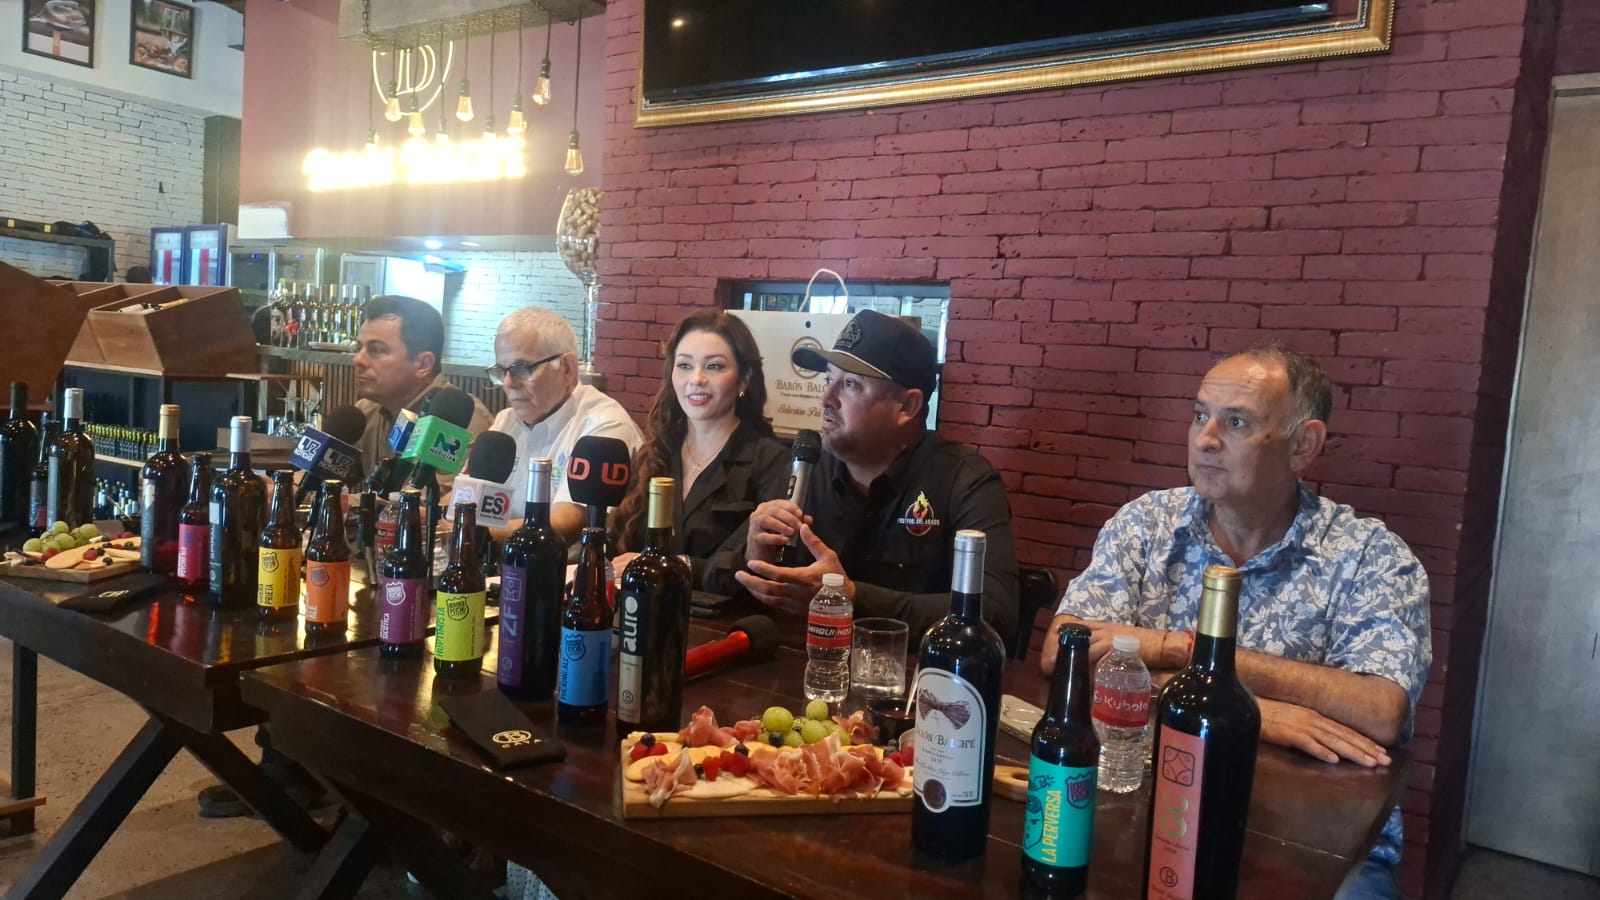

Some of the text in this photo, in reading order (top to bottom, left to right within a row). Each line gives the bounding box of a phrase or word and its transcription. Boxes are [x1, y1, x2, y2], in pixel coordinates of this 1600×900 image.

[480, 495, 503, 515] ES
[436, 608, 446, 657] HOPTIMISTA
[1041, 790, 1062, 864] LA PERVERSA
